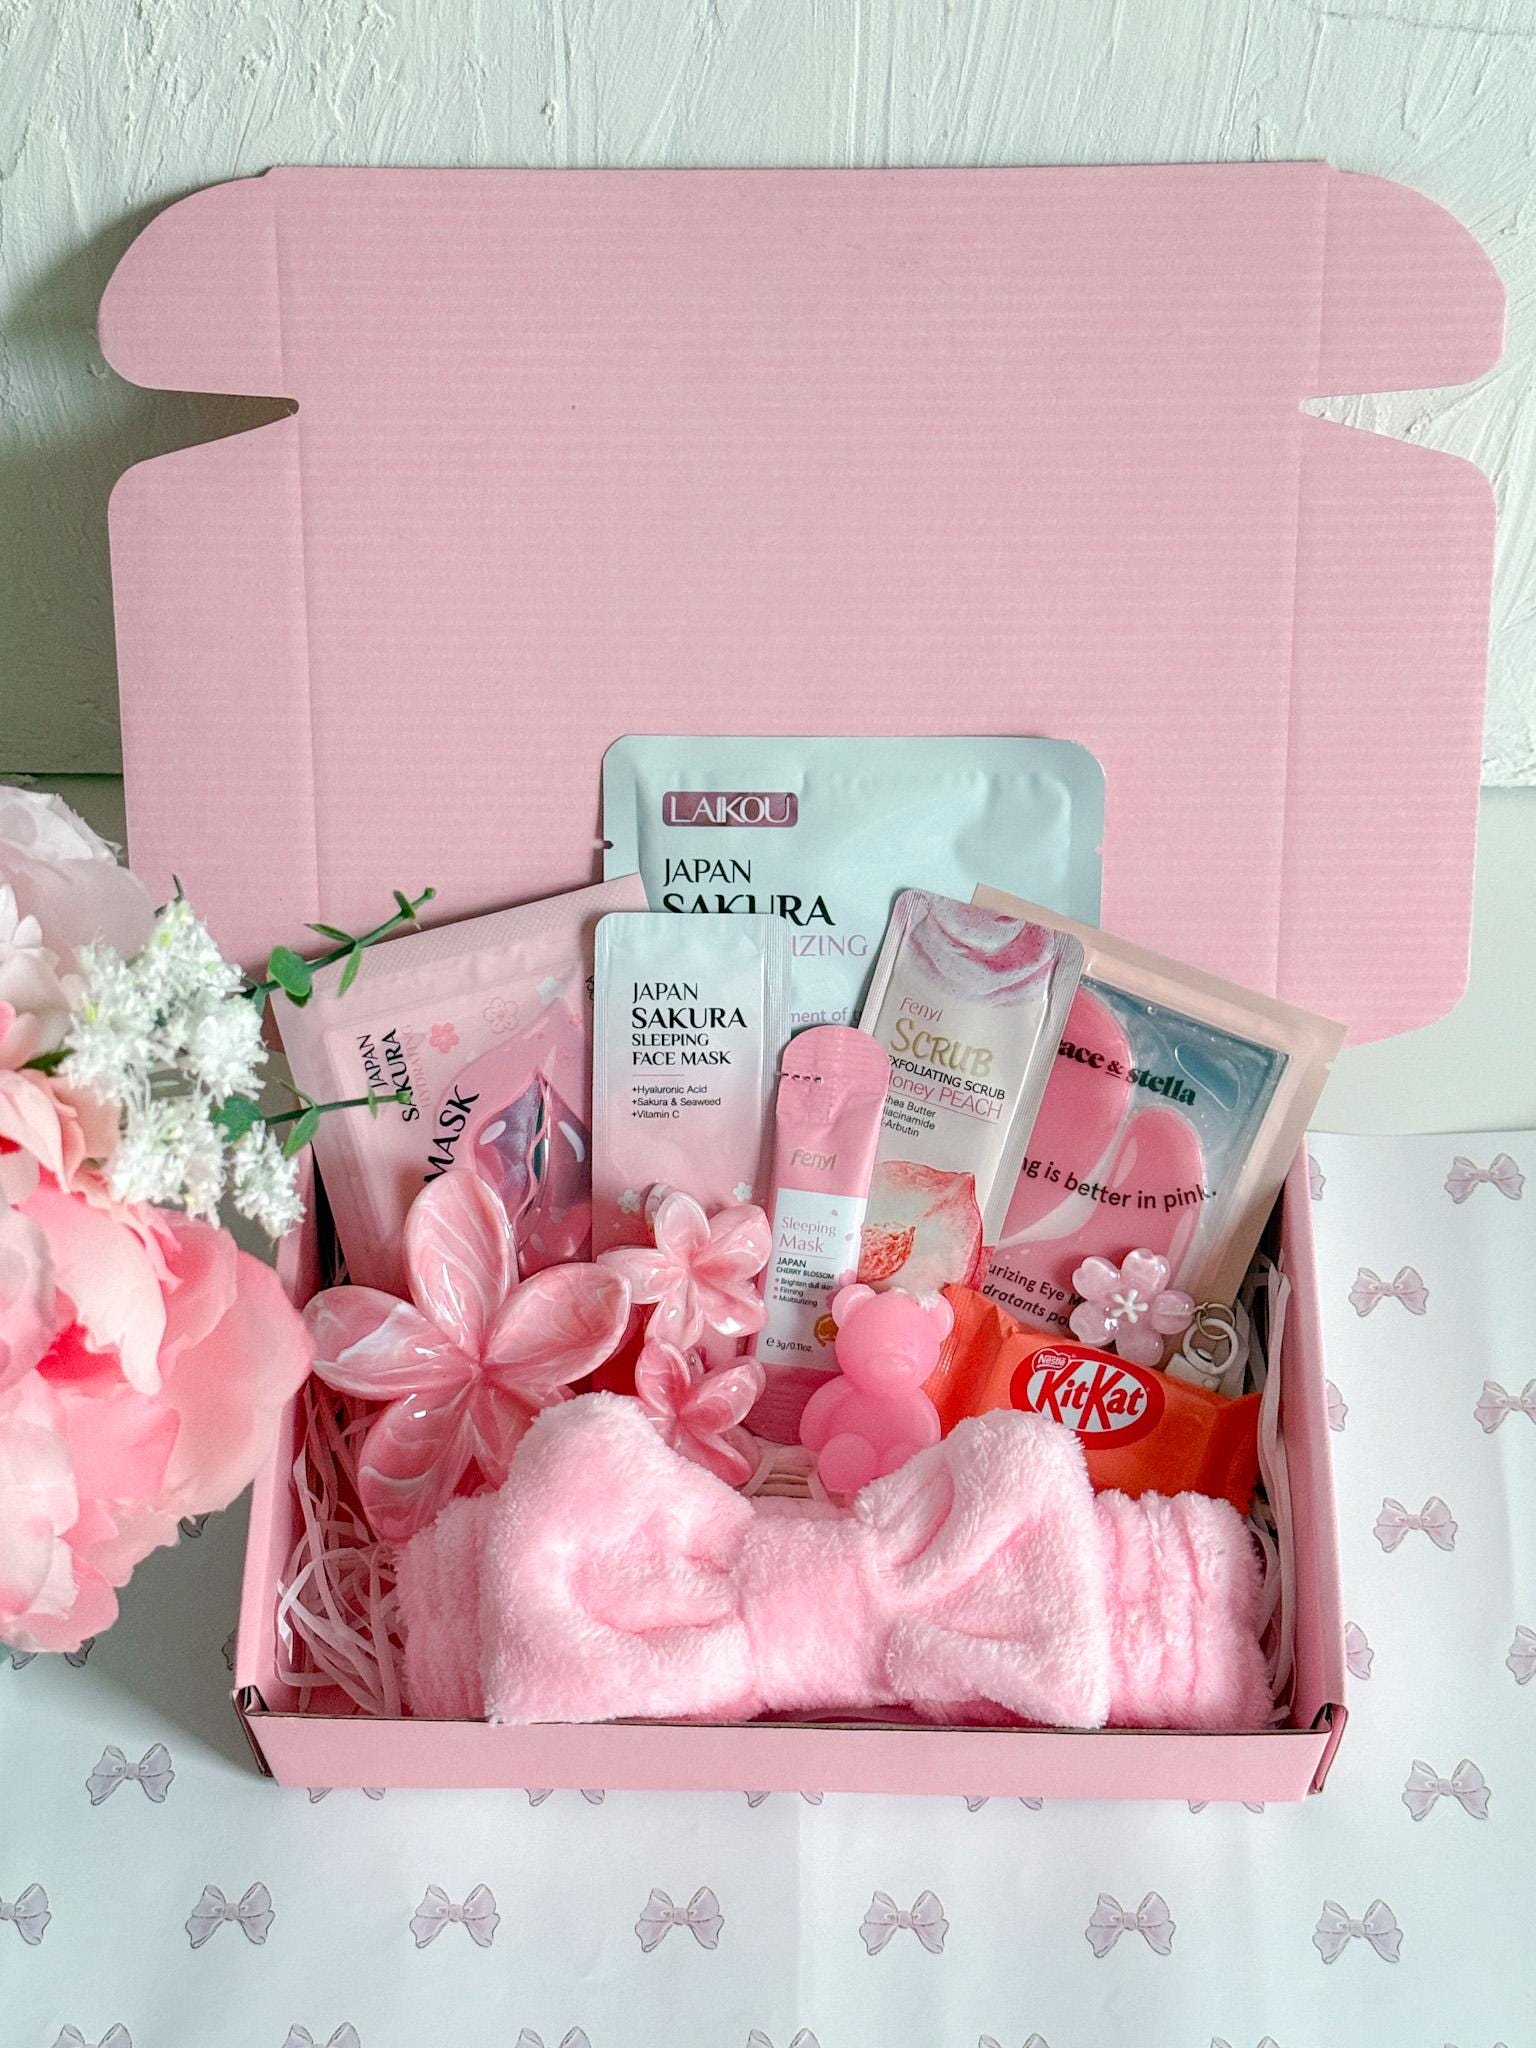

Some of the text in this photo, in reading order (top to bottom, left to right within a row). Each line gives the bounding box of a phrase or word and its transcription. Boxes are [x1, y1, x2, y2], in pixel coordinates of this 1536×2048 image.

[670, 794, 790, 823] LAIKOU
[663, 859, 751, 886] JAPAN
[663, 893, 836, 926] SAKURA
[632, 982, 698, 1004] JAPAN
[632, 1007, 748, 1029] SAKURA
[832, 1006, 848, 1022] of
[632, 1033, 709, 1047] SLEEPING
[890, 1017, 992, 1078] SCRUB
[356, 1034, 388, 1088] JAPAN
[632, 1051, 731, 1065] FACE MASK
[382, 1028, 419, 1122] SKURA
[1105, 1060, 1125, 1079] &
[1125, 1067, 1197, 1106] stella
[687, 1085, 707, 1094] Acid
[963, 1080, 1006, 1101] SCRUB
[671, 1098, 677, 1106] &
[680, 1098, 721, 1107] Seaweed
[672, 1110, 680, 1118] C
[885, 1094, 937, 1118] hea Butter
[939, 1086, 1003, 1120] PEACH
[423, 1085, 480, 1182] MASK
[1044, 1161, 1060, 1183] is
[1064, 1172, 1132, 1208] better
[1137, 1190, 1156, 1209] in
[781, 1216, 837, 1237] Sleeping
[779, 1233, 824, 1252] Mask
[776, 1266, 834, 1279] CHERRY BLOSSOM
[777, 1257, 806, 1267] JAPAN
[780, 1286, 804, 1297] Firming
[989, 1264, 1037, 1293] urizing
[1040, 1281, 1066, 1300] Eye
[982, 1284, 1047, 1317] dratants
[1035, 1361, 1144, 1430] KitKat
